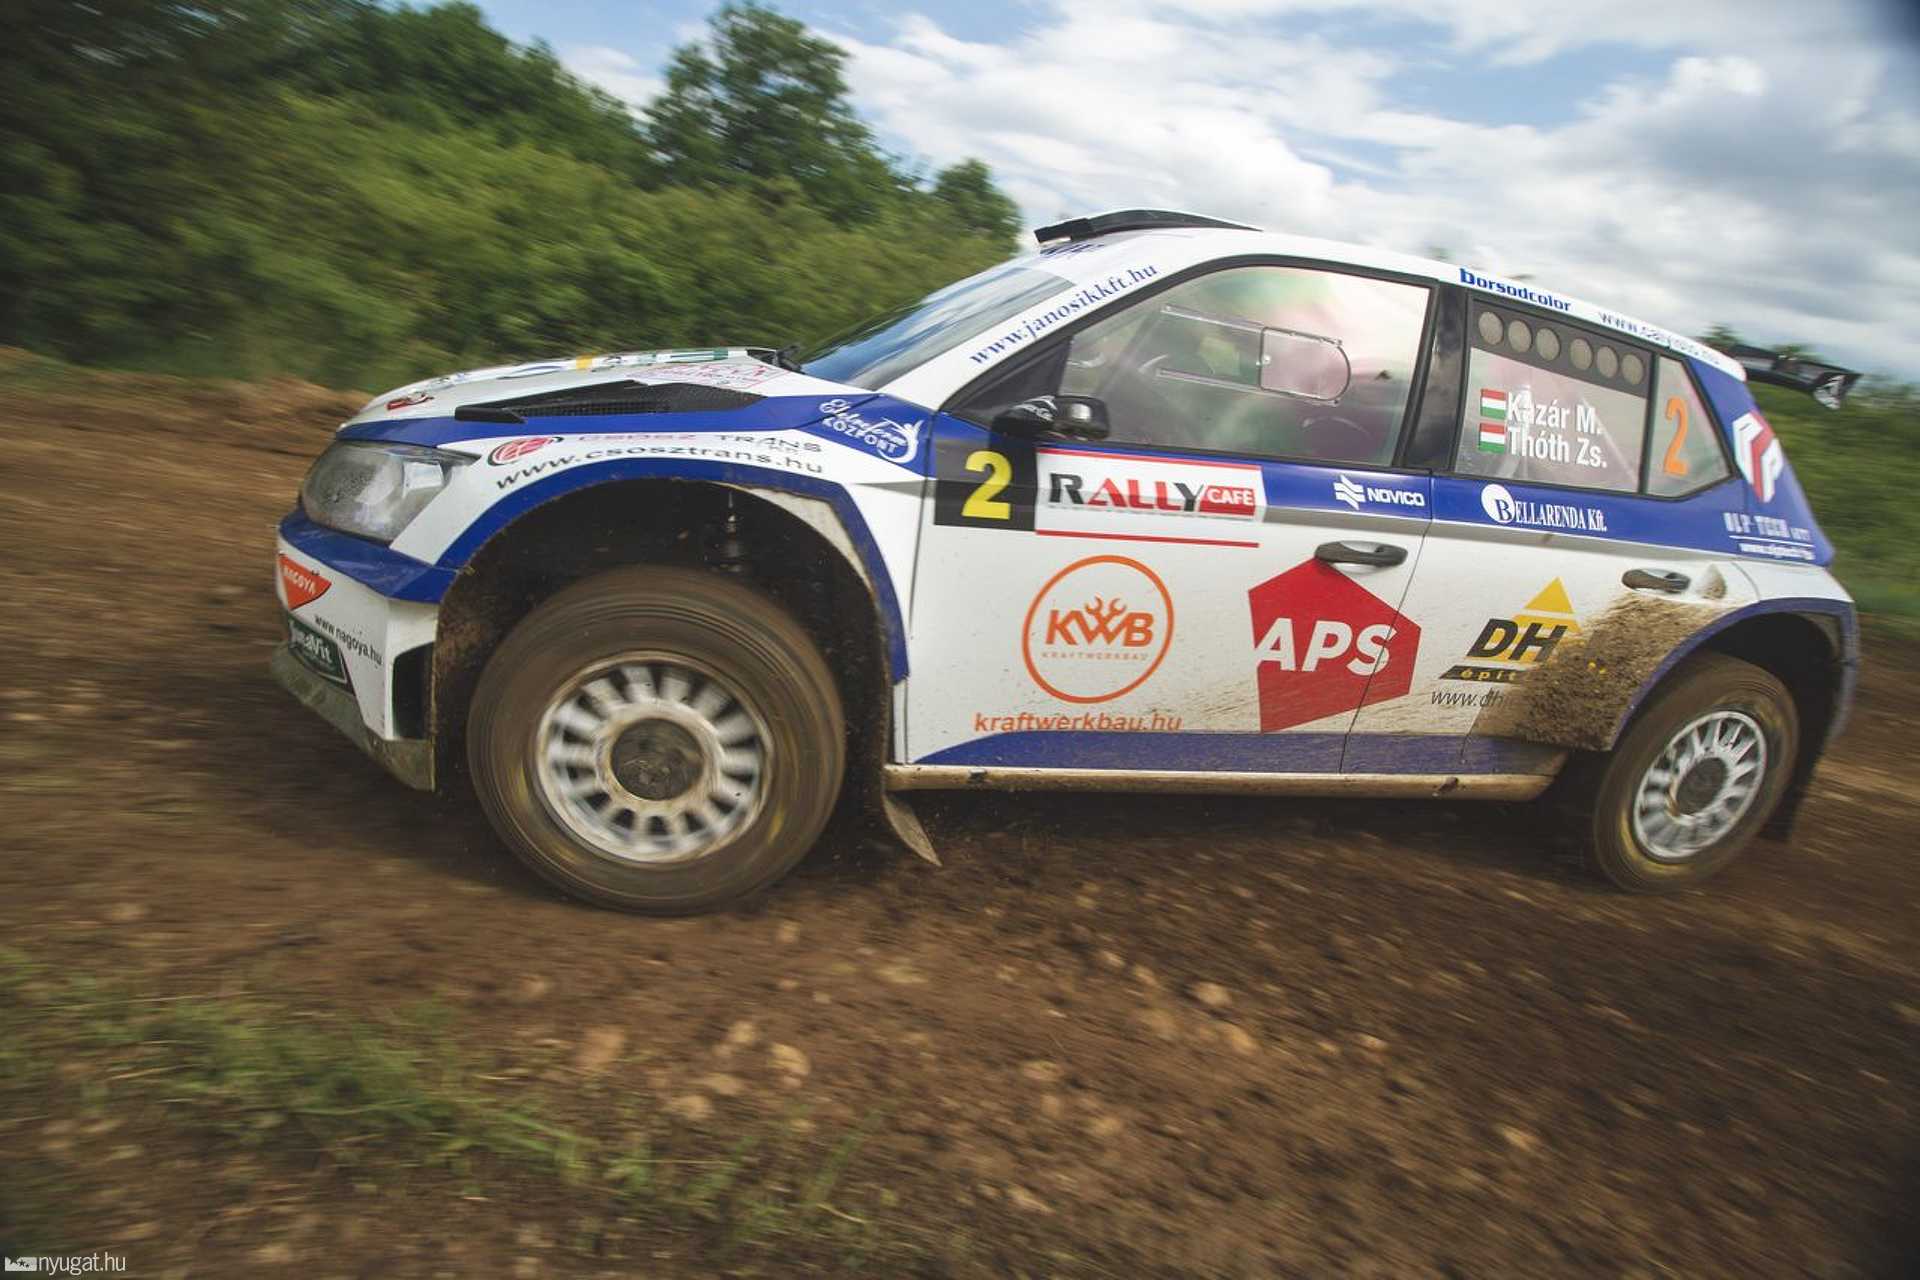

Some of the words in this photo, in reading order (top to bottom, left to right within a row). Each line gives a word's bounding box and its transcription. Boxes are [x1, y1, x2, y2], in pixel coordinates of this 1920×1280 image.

[970, 263, 1158, 364] www.janosikkft.hu
[1576, 404, 1602, 435] M.
[1663, 395, 1689, 477] 2
[496, 447, 823, 490] www.csosztrans.hu
[1507, 424, 1570, 463] Thóth
[1576, 437, 1608, 469] Zs.
[961, 449, 1013, 521] 2
[1050, 472, 1204, 513] RALLY
[1367, 487, 1425, 507] NOVICO
[1045, 596, 1155, 648] KWB
[1255, 617, 1397, 676] APS
[973, 712, 1183, 732] kraftwerkbau.hu
